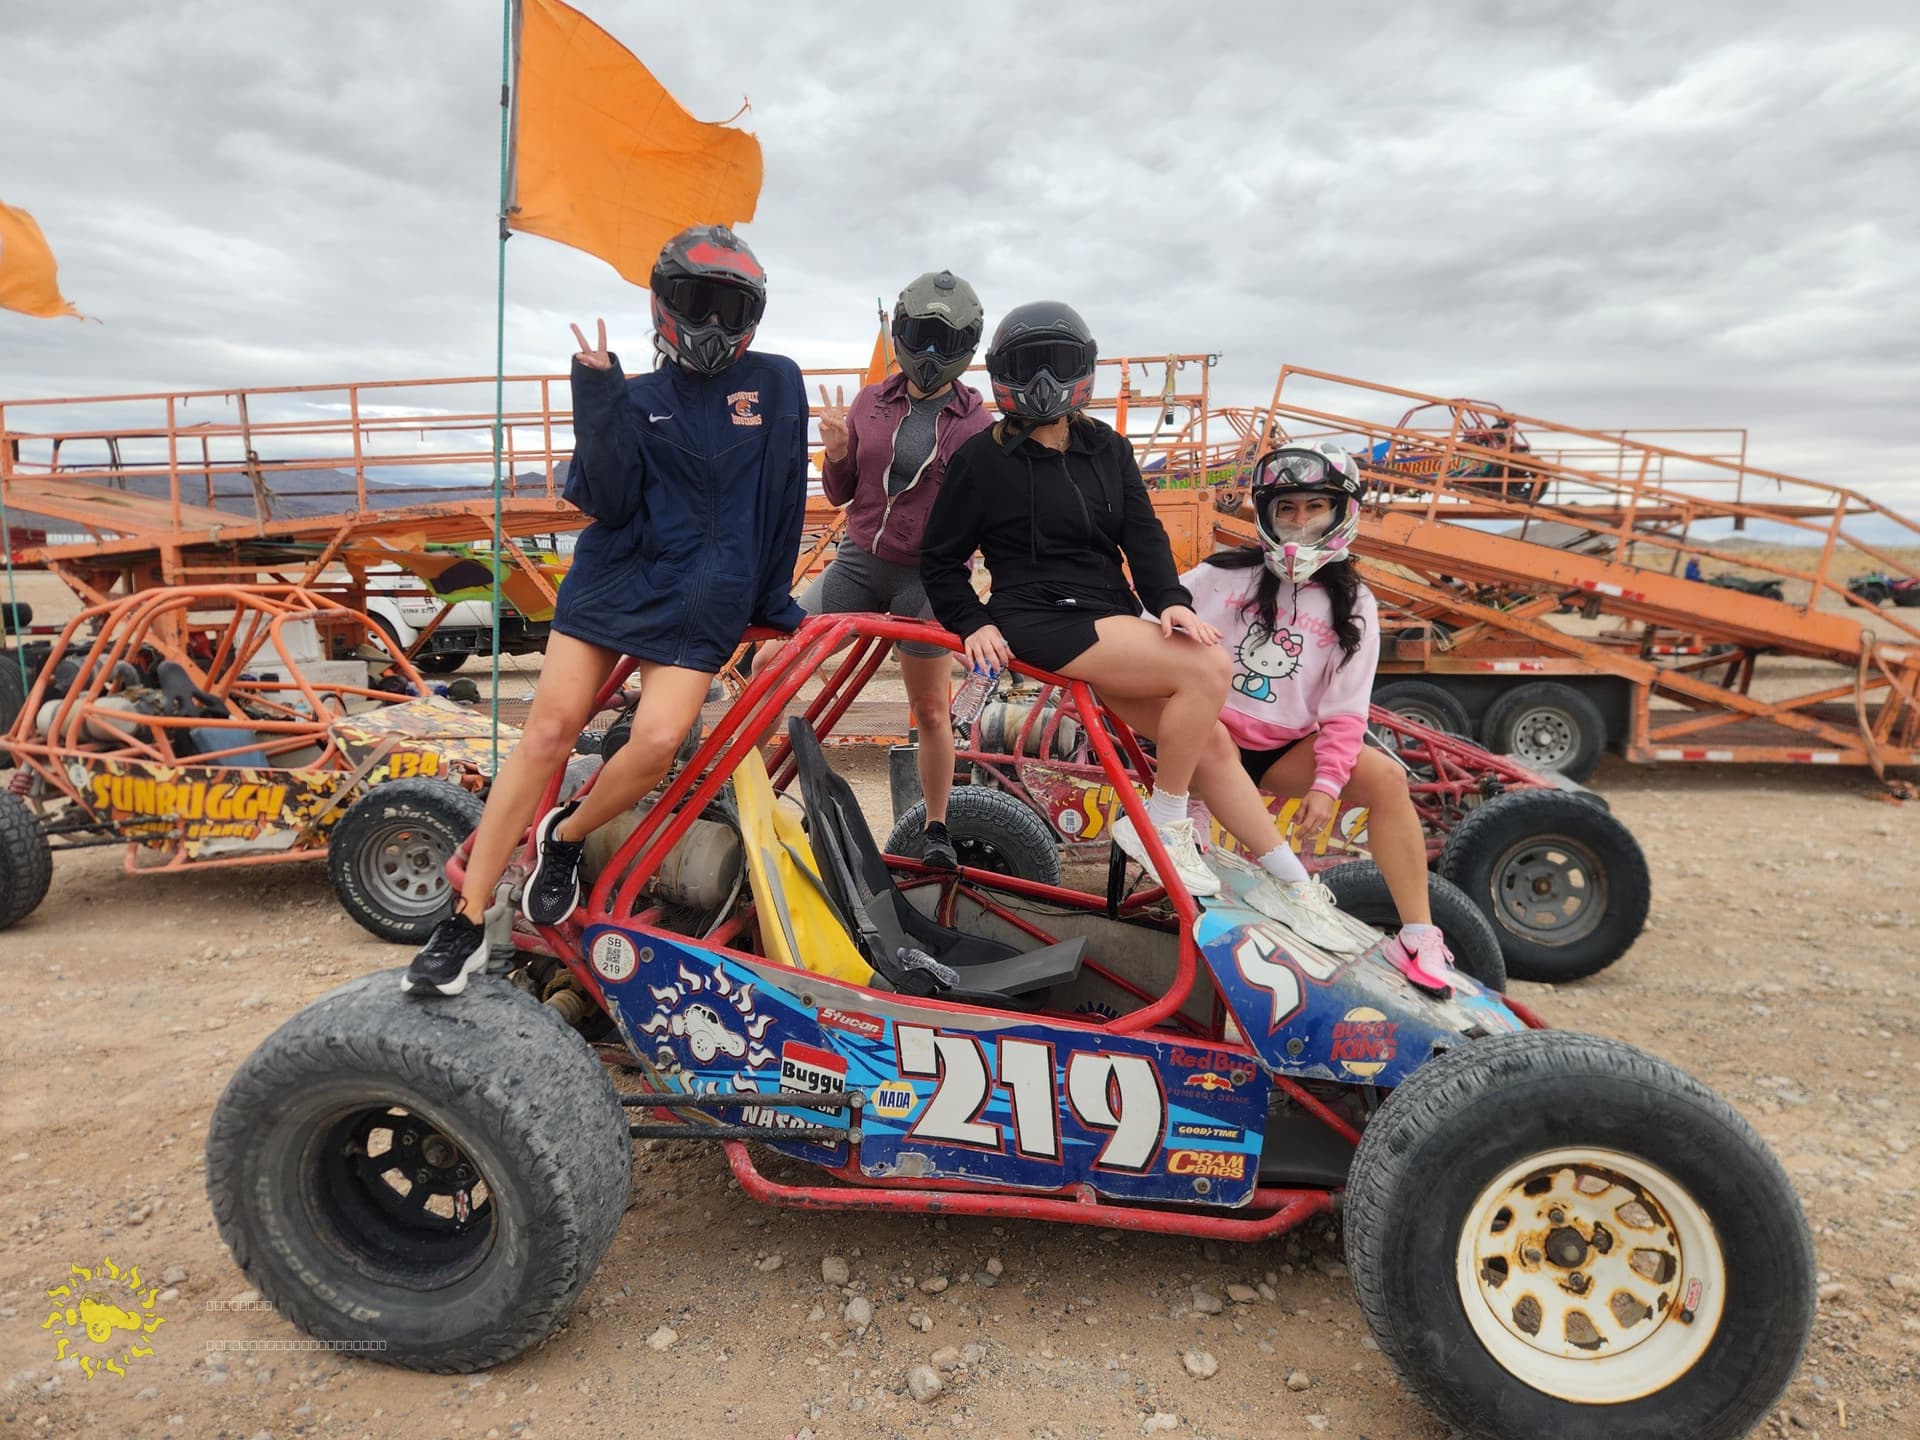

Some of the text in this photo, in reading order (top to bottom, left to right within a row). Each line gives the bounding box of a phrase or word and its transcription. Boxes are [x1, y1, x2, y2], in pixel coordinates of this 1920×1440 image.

[391, 751, 439, 778] 134
[93, 774, 287, 820] SUNBUGGY
[607, 937, 622, 947] SB
[602, 962, 620, 973] 219
[1332, 1021, 1400, 1039] BUGGY
[1329, 1038, 1397, 1062] KING
[782, 1060, 844, 1093] Buggy
[879, 1090, 910, 1109] NADA
[895, 1022, 1167, 1175] 219
